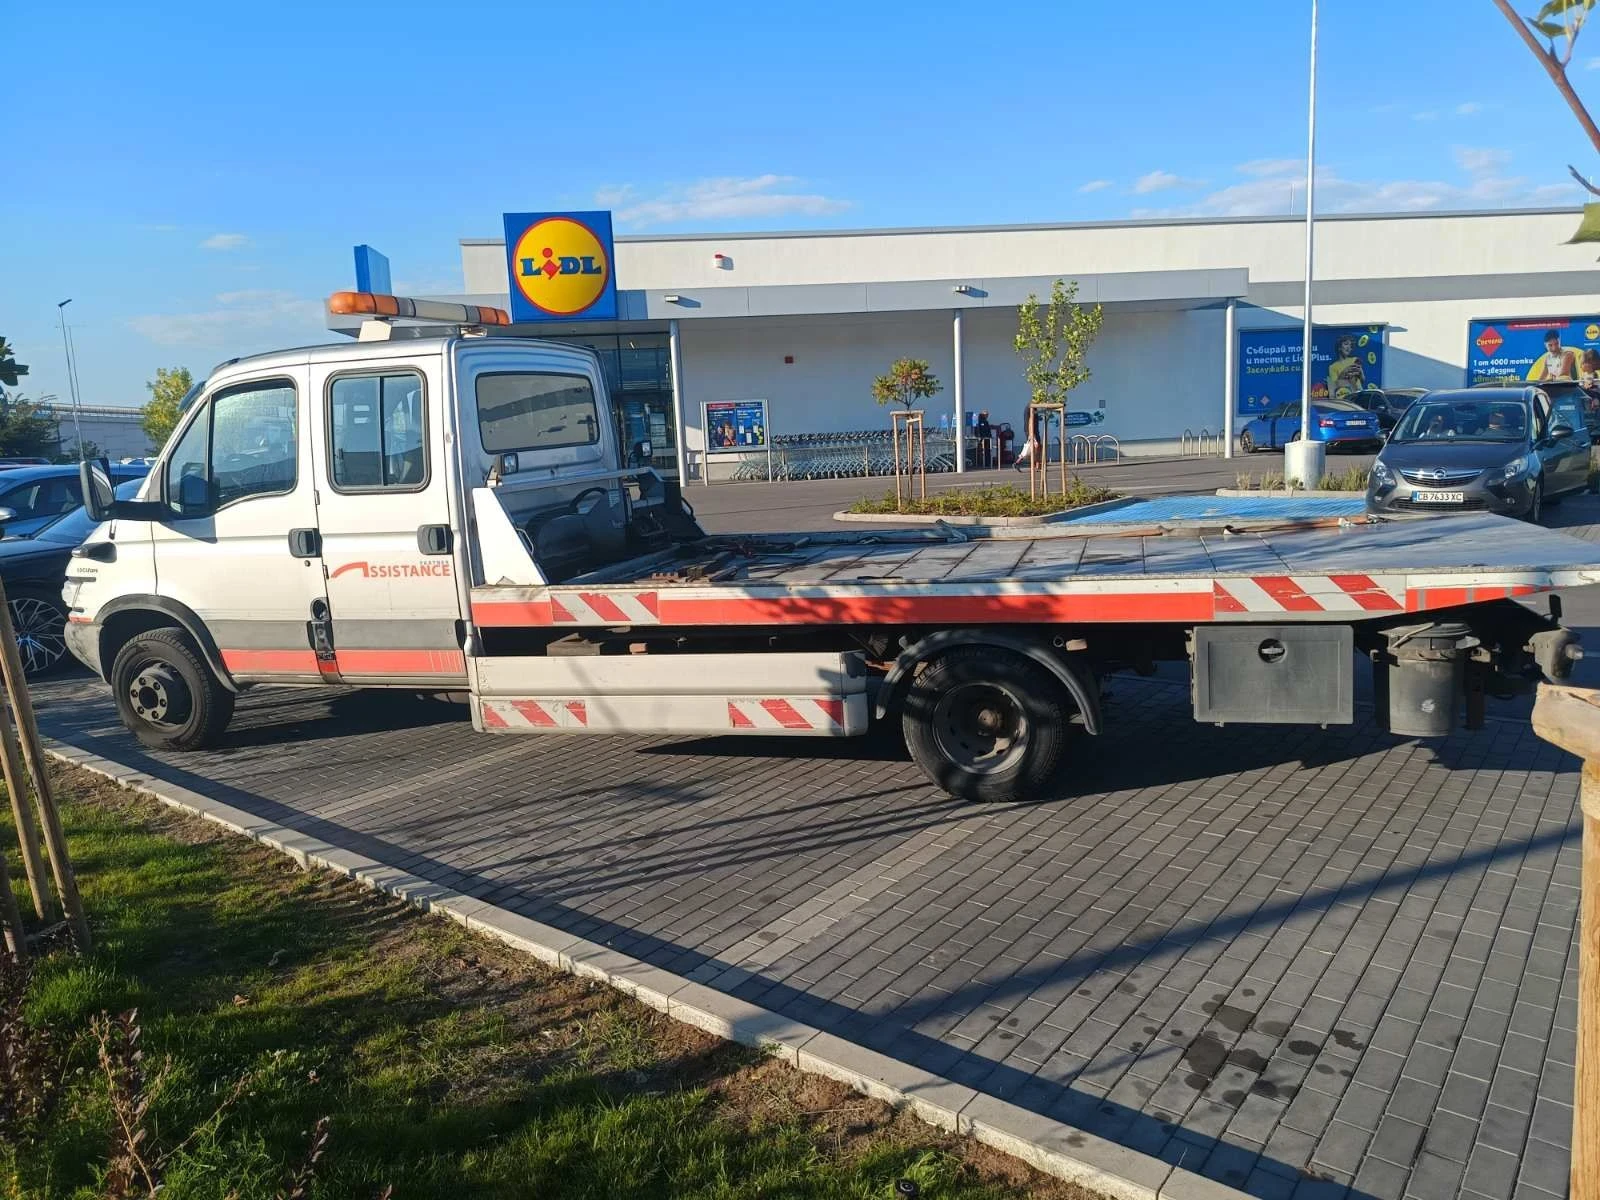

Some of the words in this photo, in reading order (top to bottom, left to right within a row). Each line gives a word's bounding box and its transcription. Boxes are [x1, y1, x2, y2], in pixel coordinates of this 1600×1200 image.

[1246, 344, 1286, 355] Събирай
[1288, 345, 1318, 353] тои
[1254, 356, 1283, 365] пести
[1490, 358, 1509, 366] 4000
